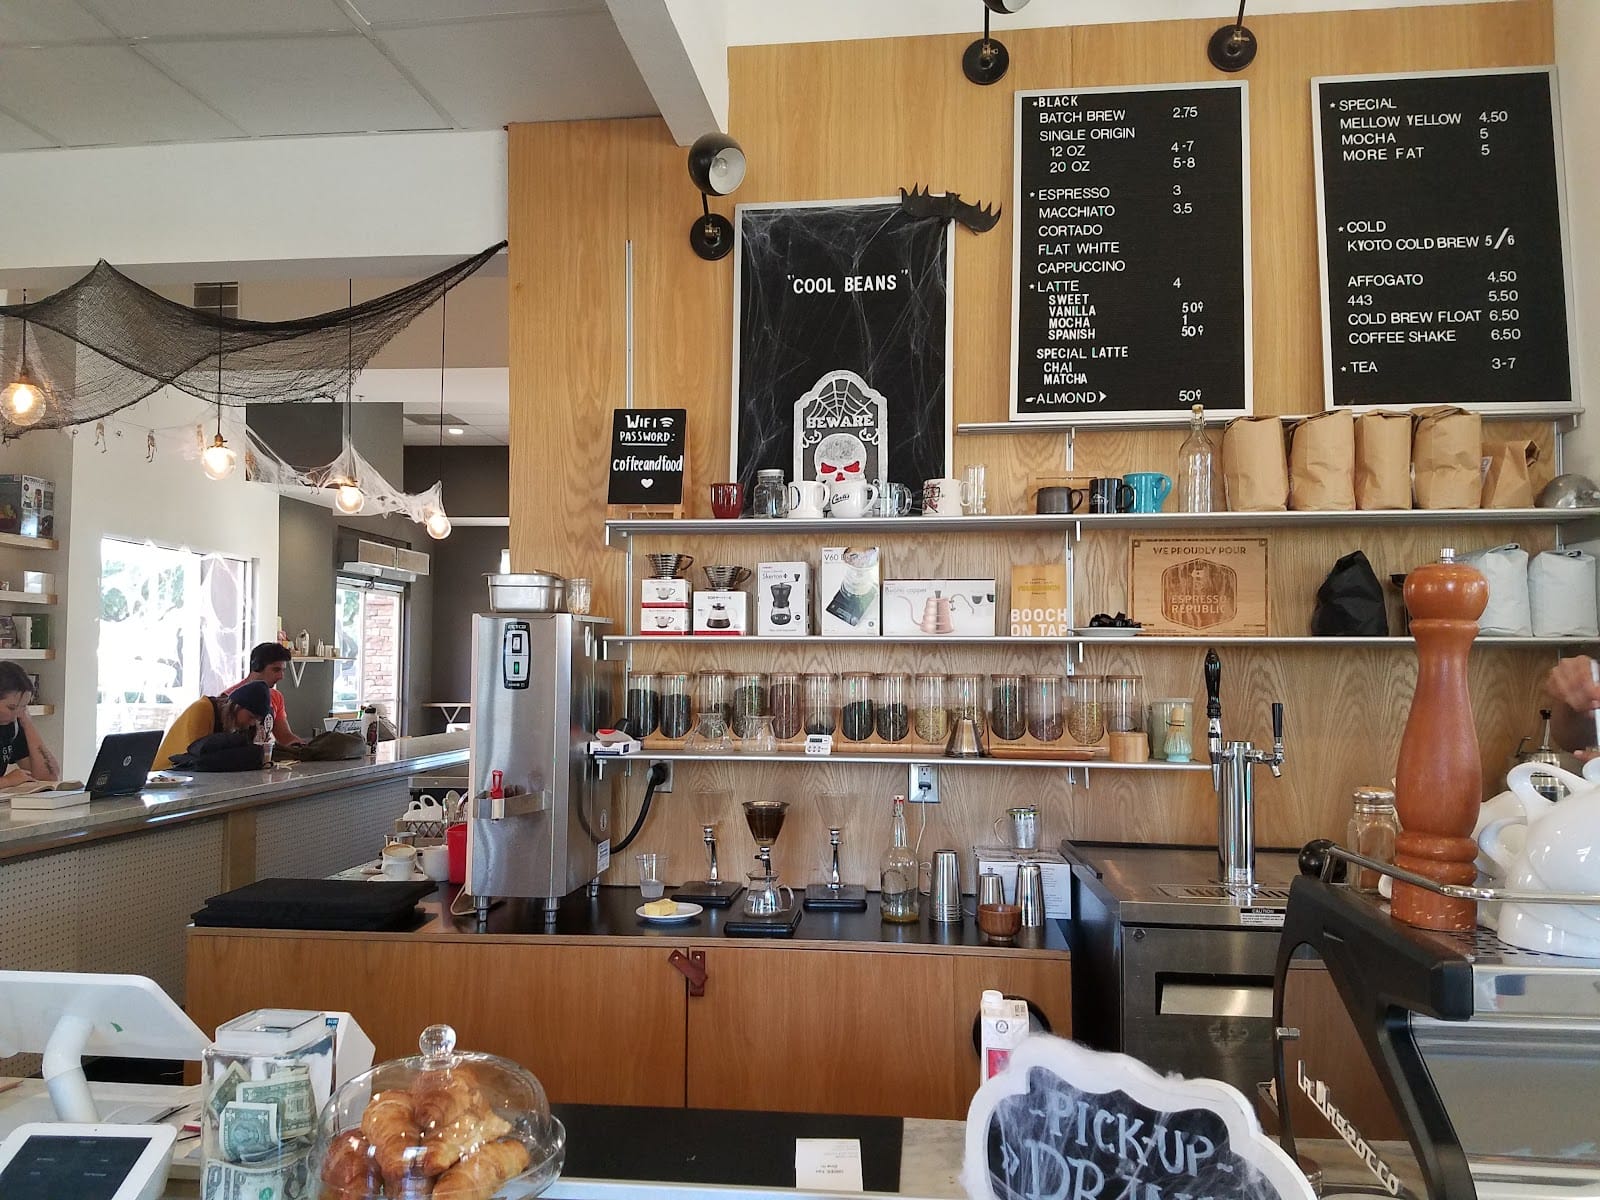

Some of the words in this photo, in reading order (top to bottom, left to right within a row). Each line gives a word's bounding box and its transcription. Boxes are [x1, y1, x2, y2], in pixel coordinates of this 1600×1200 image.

[1038, 96, 1079, 108] BLACK
[1339, 98, 1397, 112] SPECIAL
[1039, 111, 1083, 123] BATCH
[1086, 110, 1126, 122] BREW
[1172, 106, 1198, 118] 2.75
[1340, 116, 1401, 130] MELLOW
[1406, 113, 1462, 126] YELLOW
[1479, 111, 1508, 124] 4.50
[1039, 129, 1086, 141] SINGLE
[1090, 128, 1136, 140] ORIGIN
[1341, 133, 1397, 145] MOCHA
[1479, 128, 1489, 140] 5
[1050, 146, 1063, 157] 12
[1066, 145, 1086, 157] OZ
[1343, 149, 1388, 161] MORE
[1395, 147, 1424, 160] FAT
[1481, 144, 1490, 156] 5
[1049, 162, 1067, 173] 20
[1071, 161, 1091, 172] OZ
[1172, 157, 1196, 169] 5-8
[1038, 187, 1110, 201] ESPRESSO
[1172, 185, 1182, 196] 3
[1039, 205, 1116, 219] MACCHIATO
[1172, 203, 1193, 215] 3.5
[1038, 224, 1103, 237] CORTADO
[1346, 221, 1387, 234] COLD
[1038, 243, 1070, 256] FLAT
[1076, 241, 1120, 254] WHITE
[1347, 239, 1393, 252] KYOTO
[1396, 238, 1434, 251] COLD
[1437, 236, 1480, 249] BREW
[1037, 260, 1126, 274] CAPPUCCINO
[1037, 280, 1080, 293] LATTE
[1172, 277, 1182, 288] 4
[1347, 274, 1424, 287] AFFOGATO
[1487, 270, 1517, 283] 4.50
[1048, 294, 1090, 305] SWEET
[1347, 294, 1373, 306] 443
[1488, 290, 1518, 302] 5.50
[1048, 304, 1096, 317] VANILLA
[1348, 313, 1386, 326] COLD
[1391, 311, 1433, 324] BREW
[1438, 310, 1482, 323] FLOAT
[1489, 309, 1519, 322] 6.50
[1048, 316, 1091, 329] MOCHA
[1048, 328, 1096, 341] SPANISH
[1349, 331, 1405, 345] COFFEE
[1408, 330, 1456, 343] SHAKE
[1490, 328, 1521, 341] 6.50
[1036, 347, 1087, 360] SPECIAL
[1091, 346, 1129, 359] LATTE
[1043, 361, 1073, 373] CHAI
[1350, 361, 1378, 373] TEA
[1043, 373, 1088, 385] MATCHA
[1036, 391, 1097, 404] ALMOND
[806, 414, 875, 429] BEWARE
[620, 430, 676, 442] PASSWORD:
[1153, 547, 1169, 555] WE
[1171, 546, 1217, 555] PROUDLY
[1218, 546, 1246, 555] POUR
[1172, 595, 1227, 604] ESPRESSO
[1011, 608, 1067, 622] BOOCH
[1011, 624, 1032, 637] ON
[1038, 623, 1067, 637] TAP
